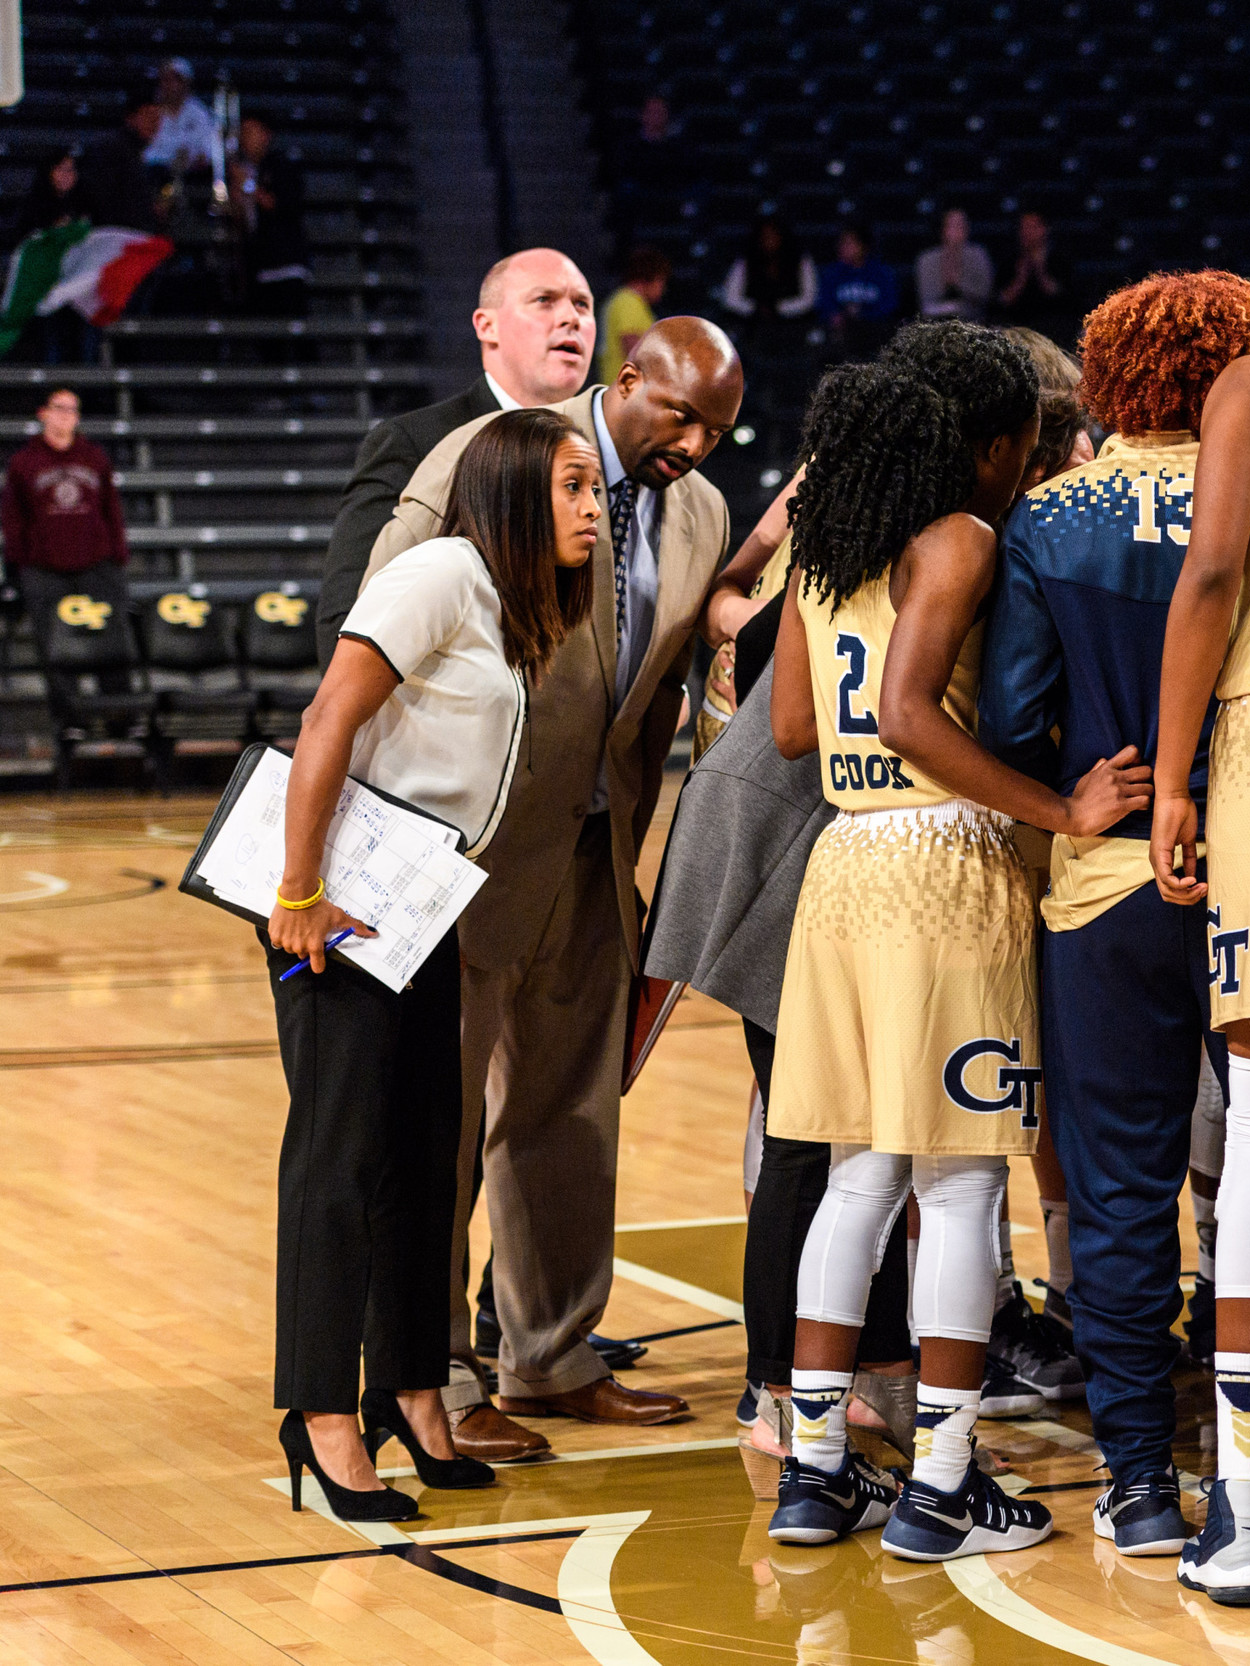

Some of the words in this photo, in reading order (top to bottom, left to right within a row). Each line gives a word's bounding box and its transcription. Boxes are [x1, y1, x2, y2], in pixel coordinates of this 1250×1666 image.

[835, 630, 879, 738] 2
[829, 753, 916, 791] COOK
[942, 1037, 1042, 1129] GT
